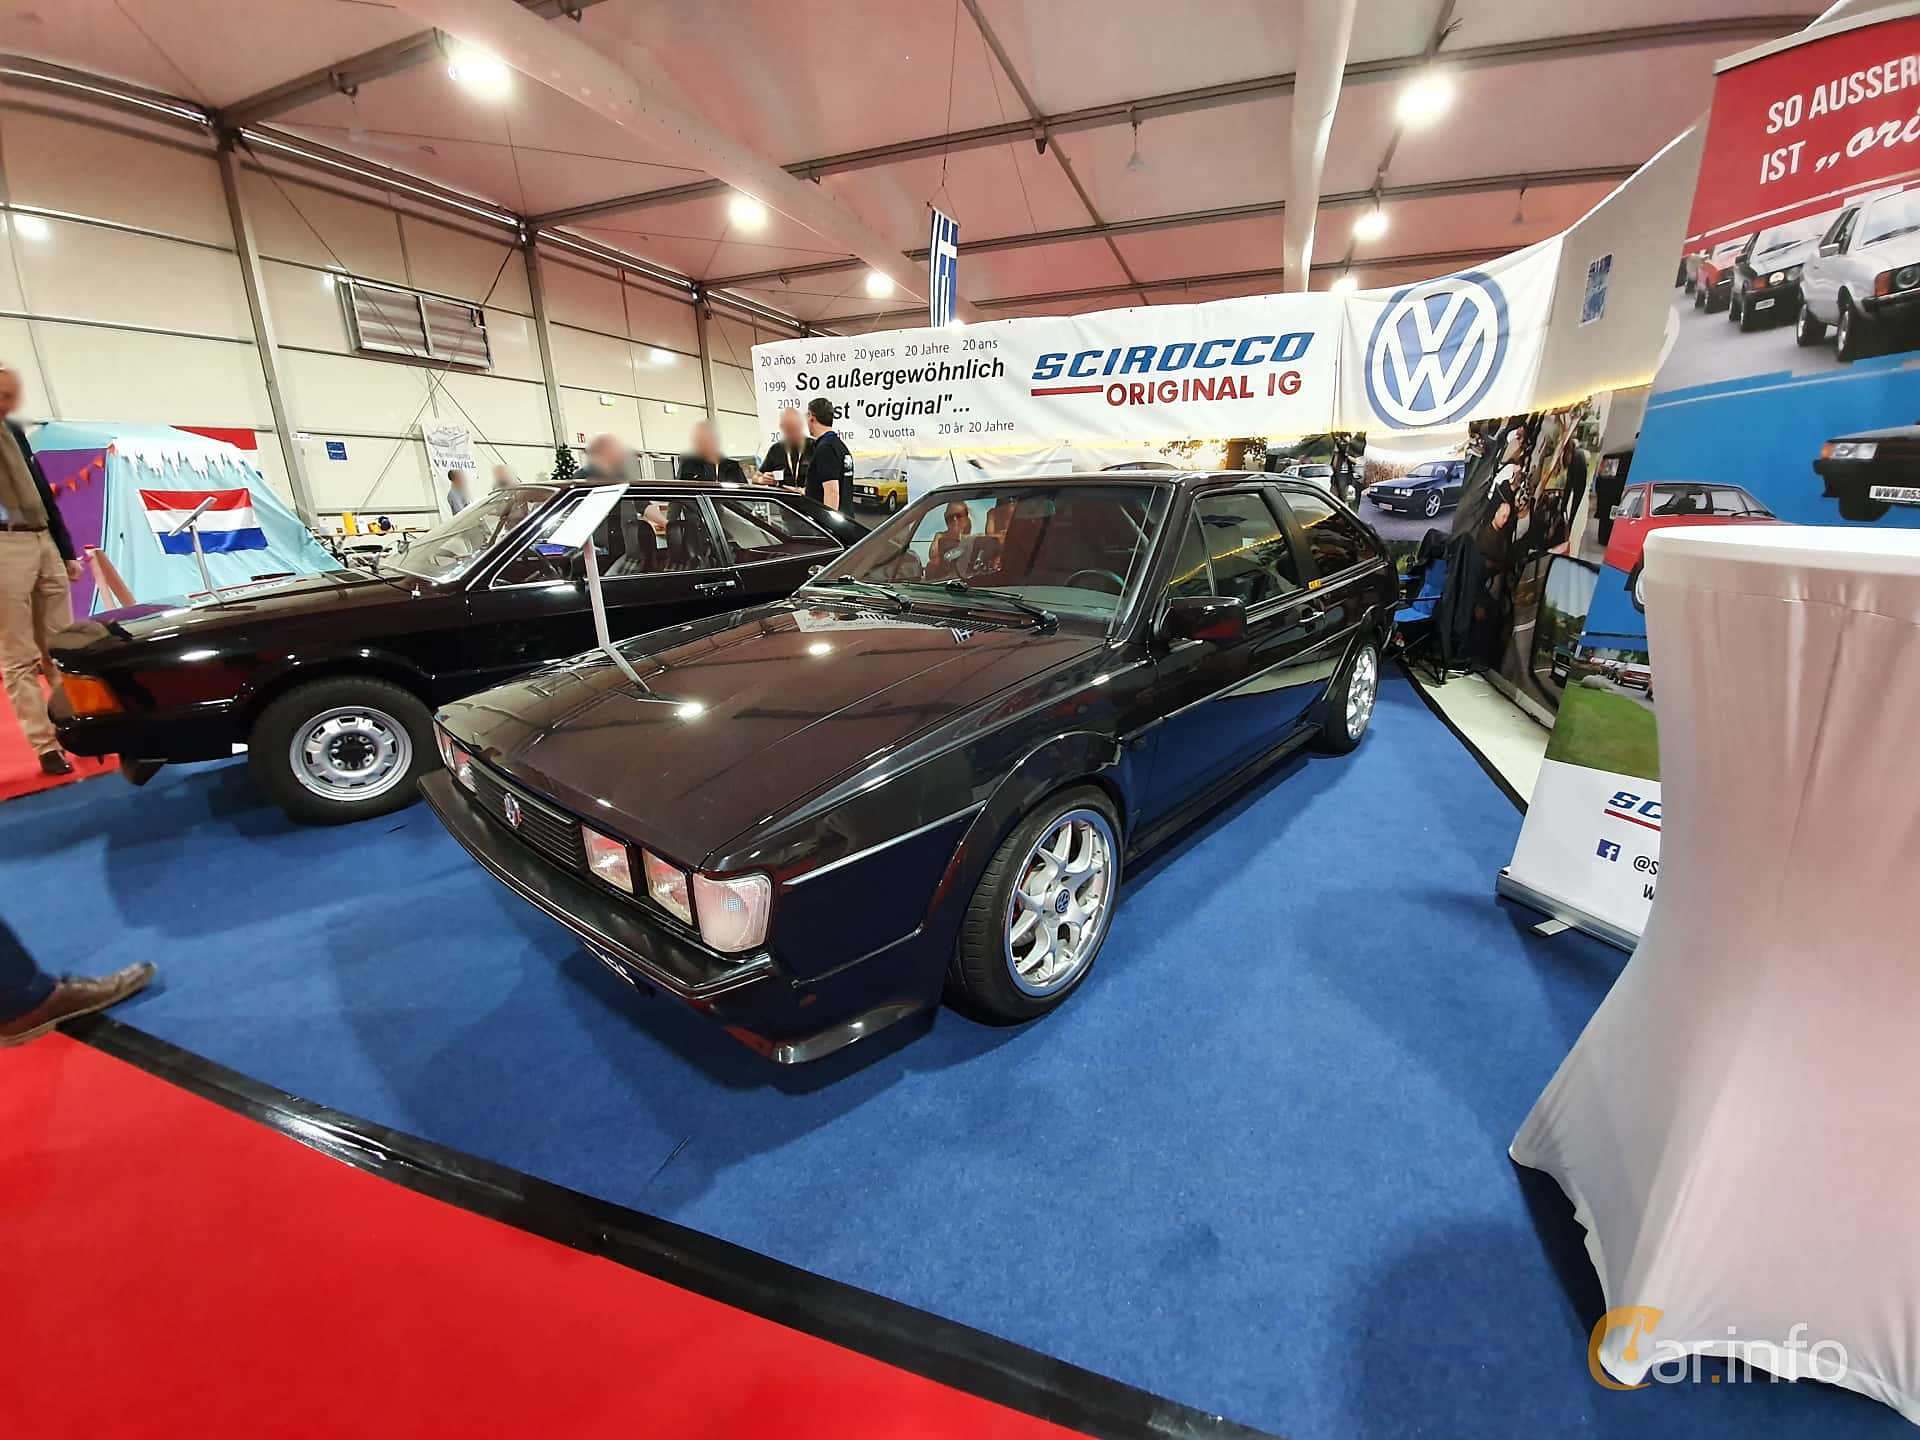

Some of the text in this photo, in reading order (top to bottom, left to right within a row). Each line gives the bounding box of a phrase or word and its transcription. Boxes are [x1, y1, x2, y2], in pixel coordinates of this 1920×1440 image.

[1766, 54, 1920, 134] SO AUSSER
[1760, 141, 1806, 185] IST
[761, 339, 998, 366] 20 años 20 Jahre 20 years 20 Jahre 20 ans
[1032, 332, 1315, 380] SCIROCCO
[764, 382, 786, 392] 1999
[795, 357, 1004, 391] So außergewöhnlich
[1107, 370, 1302, 406] ORIGINAL IG
[777, 399, 801, 409] 2019
[833, 402, 850, 419] st
[838, 429, 854, 440] hre
[869, 428, 881, 438] 20
[882, 427, 915, 438] vuotta
[938, 424, 951, 434] 20
[952, 421, 964, 433] år
[969, 422, 982, 433] 20
[984, 420, 1014, 433] Jahre
